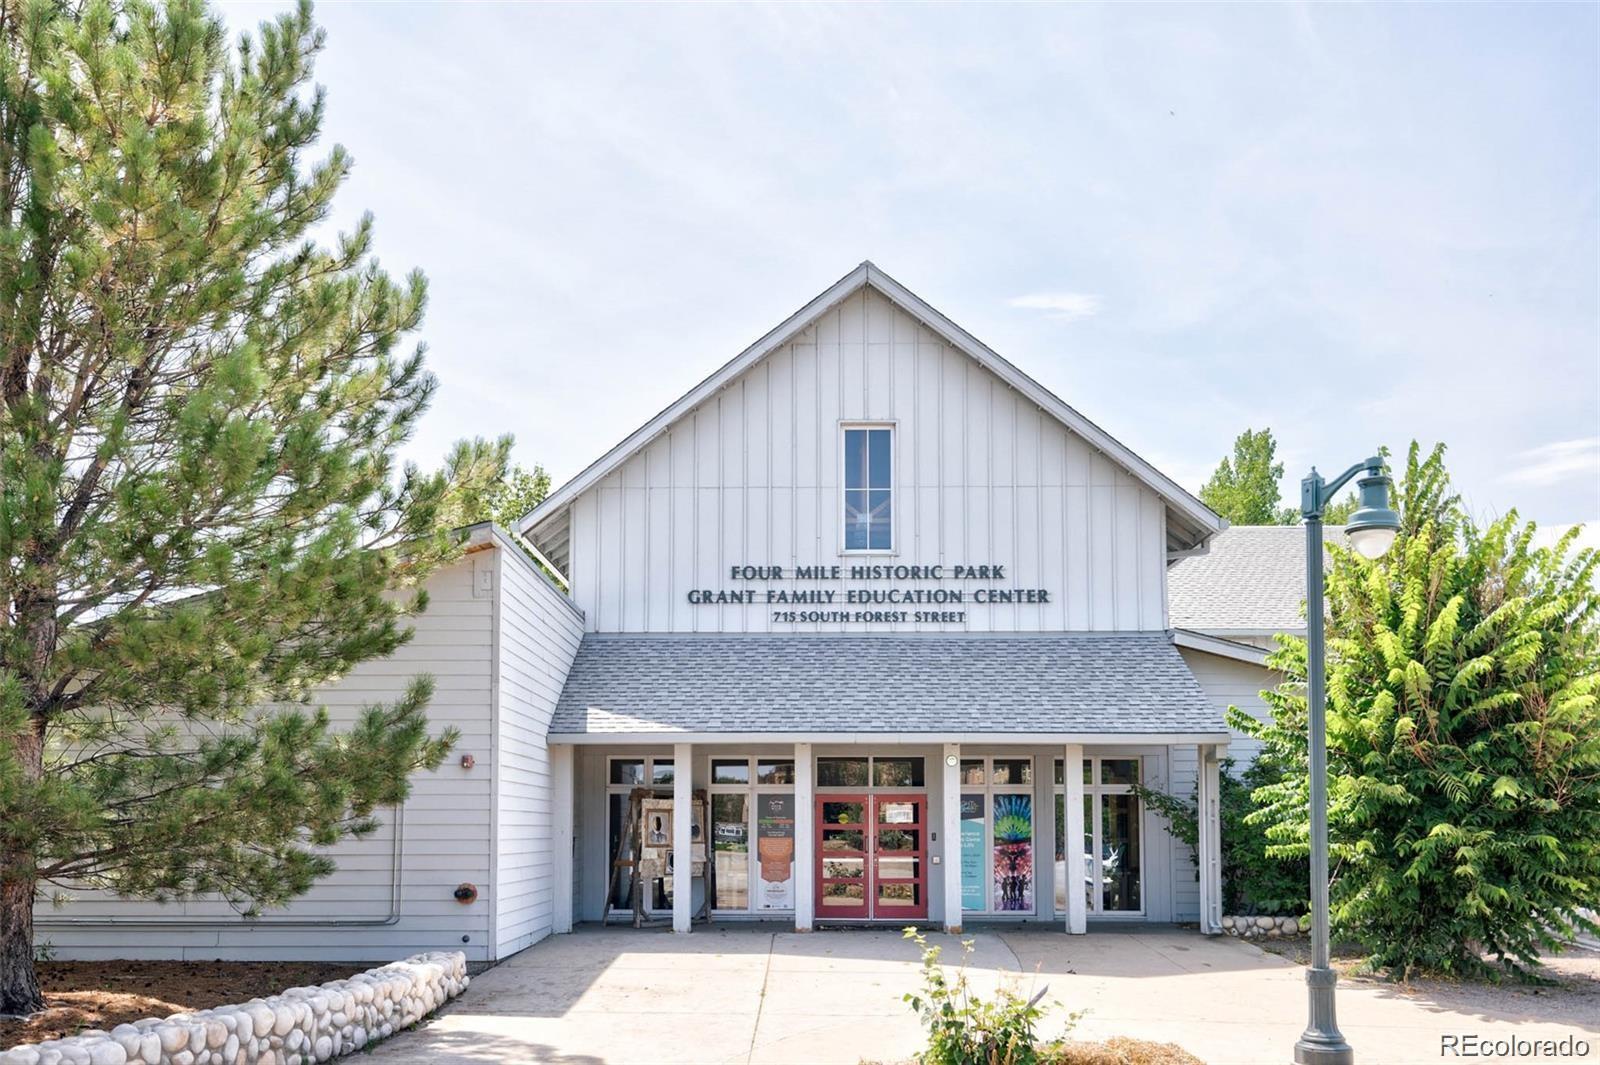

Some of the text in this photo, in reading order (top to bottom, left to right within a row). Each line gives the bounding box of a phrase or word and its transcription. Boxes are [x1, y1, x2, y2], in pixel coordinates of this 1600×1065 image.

[730, 565, 1005, 581] FOUR MILE HISTORIC PARK
[687, 589, 1050, 605] GRANT FAMILY EDUCATION CENTER
[774, 611, 966, 623] 715 SOUTH FOREST STREET
